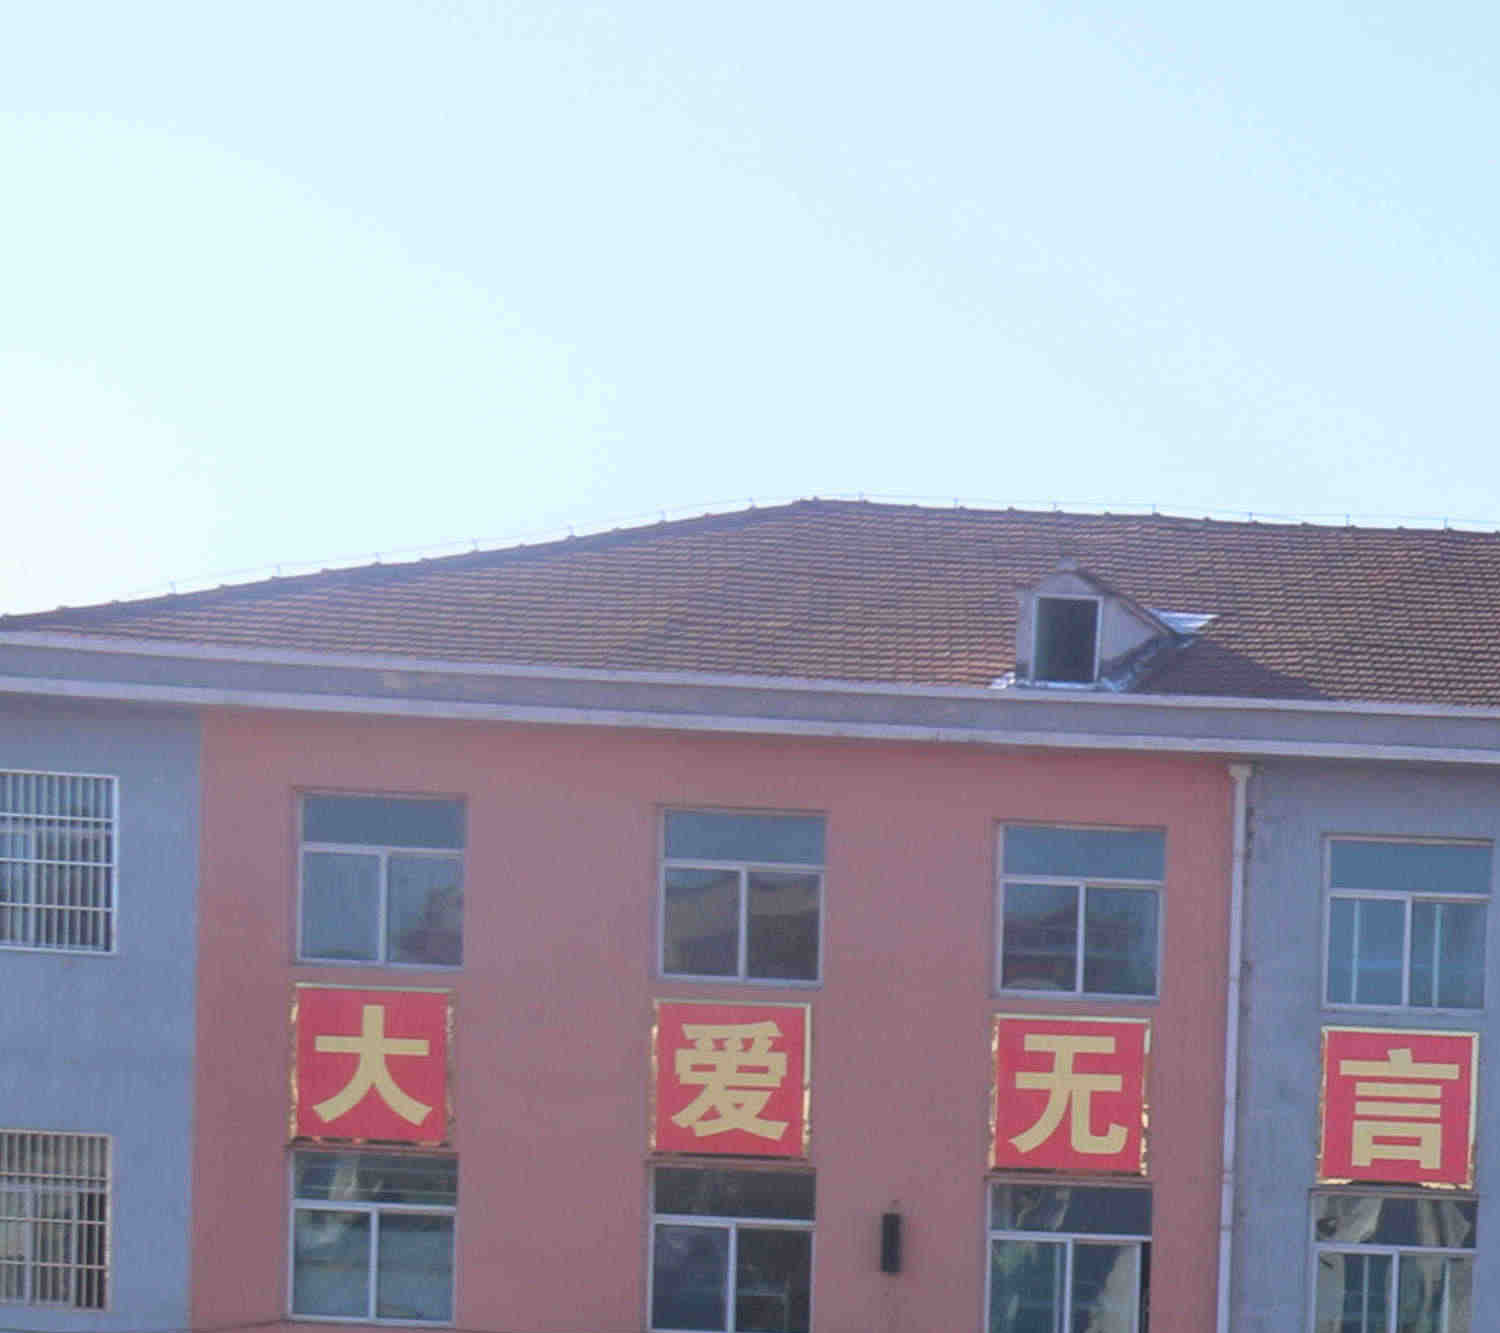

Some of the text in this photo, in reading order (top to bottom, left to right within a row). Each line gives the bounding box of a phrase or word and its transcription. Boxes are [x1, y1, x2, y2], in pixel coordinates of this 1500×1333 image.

[316, 1005, 432, 1123] 大
[672, 1023, 784, 1139] 爱
[1016, 1035, 1128, 1153] 无
[1343, 1047, 1456, 1168] 言
